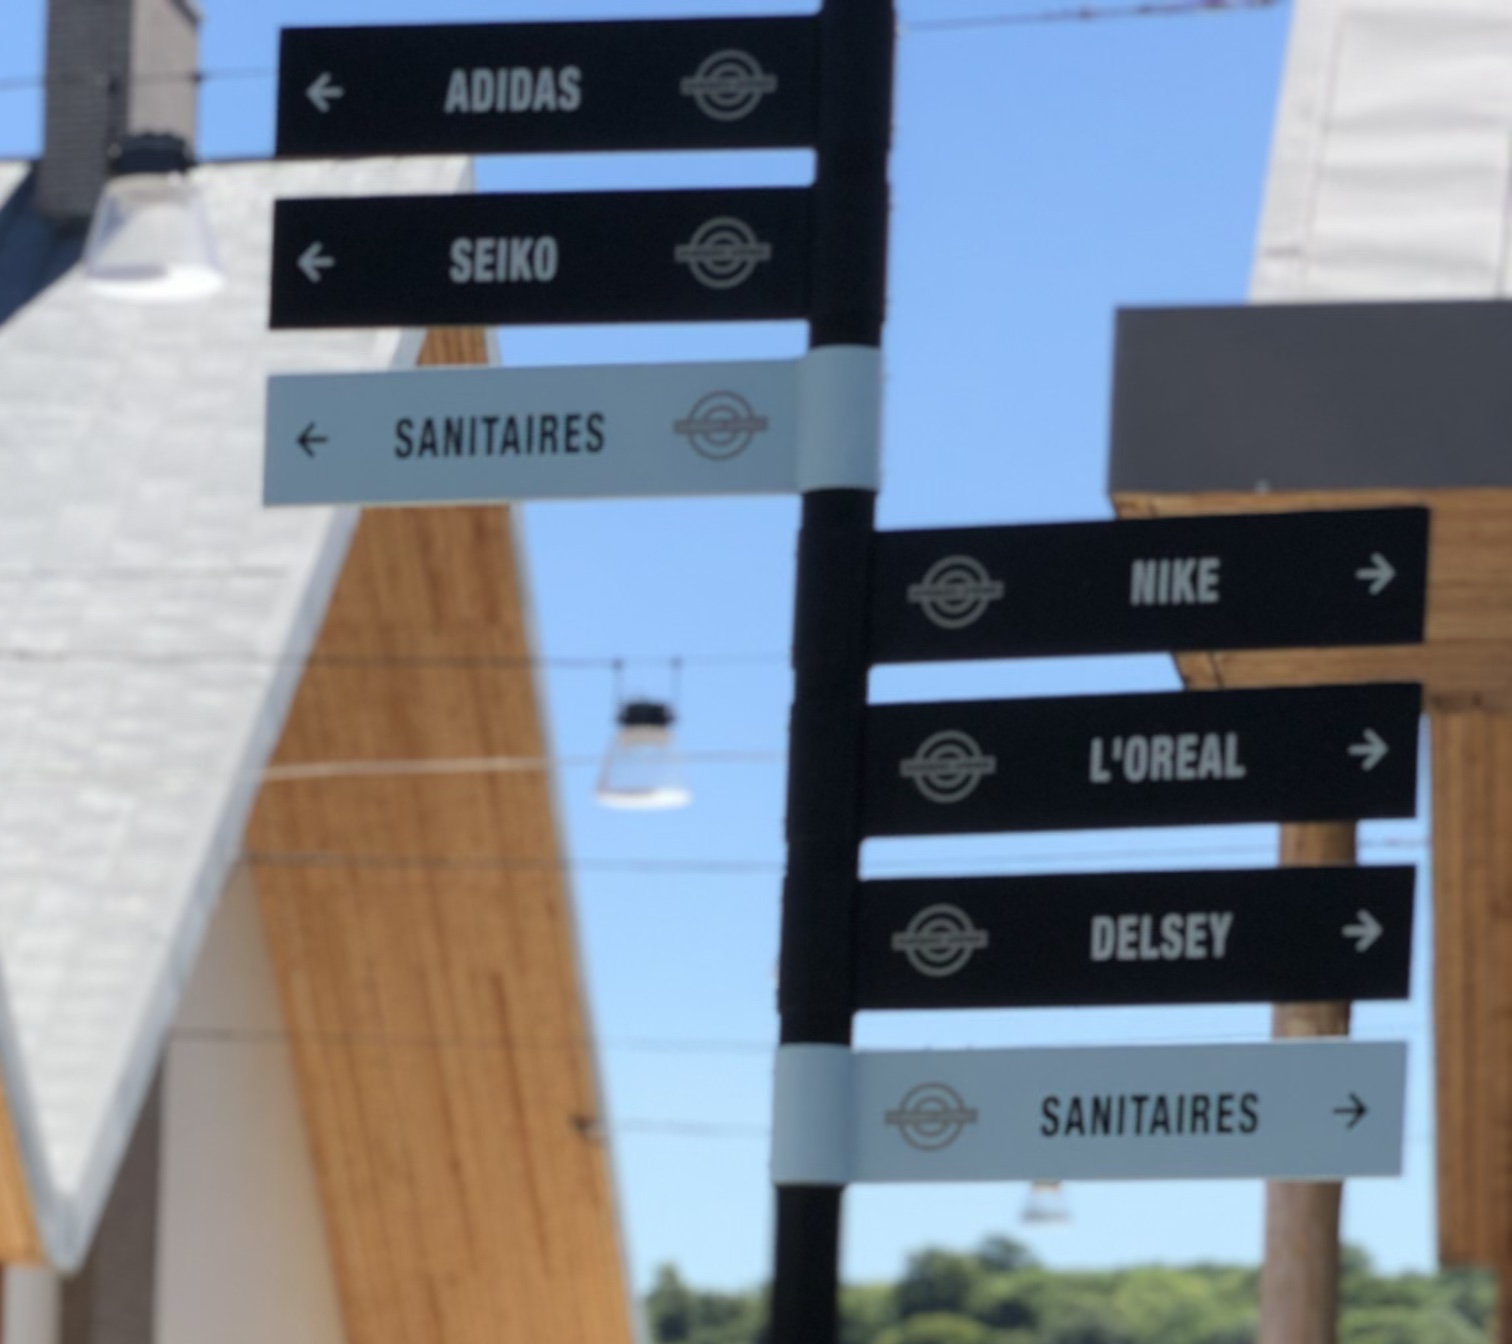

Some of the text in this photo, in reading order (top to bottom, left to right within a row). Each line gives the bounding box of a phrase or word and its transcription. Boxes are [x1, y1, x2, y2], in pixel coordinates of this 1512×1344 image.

[444, 65, 583, 114] ADIDAS
[449, 235, 559, 284] SEIKO
[394, 412, 606, 460] SANITAIRES
[1130, 556, 1221, 606] NIKE
[1089, 732, 1247, 784] L'OREAL
[1090, 911, 1234, 962] DELSEY
[1040, 1092, 1260, 1138] SANITAIRES
